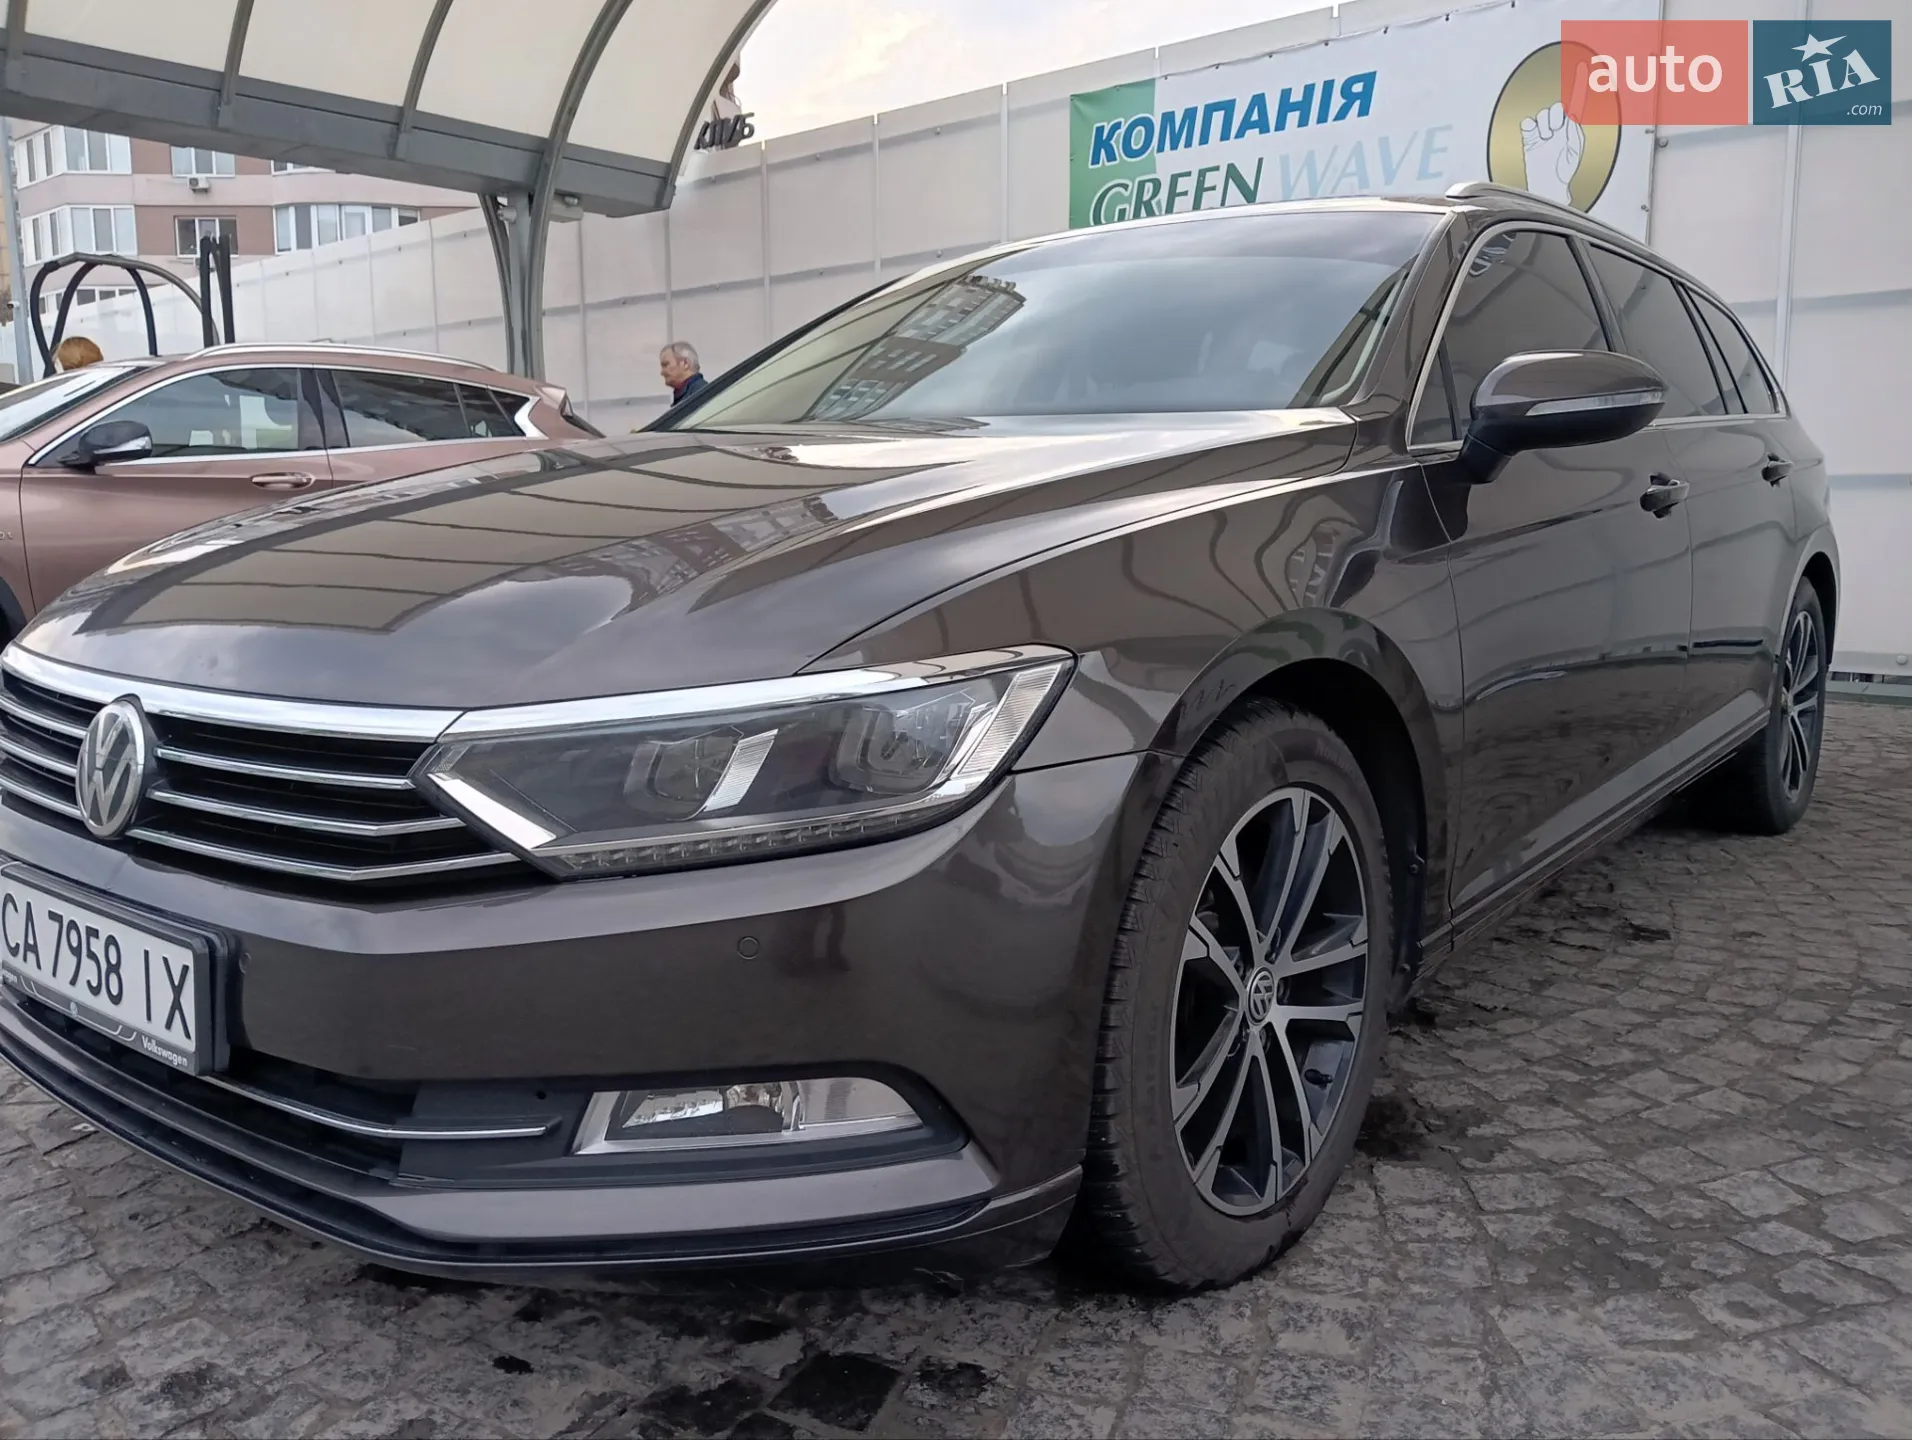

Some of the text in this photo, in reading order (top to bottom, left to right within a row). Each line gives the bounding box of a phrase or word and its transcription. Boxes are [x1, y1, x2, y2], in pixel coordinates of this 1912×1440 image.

[1089, 70, 1378, 167] КОМПАНІЯ
[1091, 124, 1453, 226] GREEN WAVE
[2, 893, 192, 1041] CA 7958 IX
[141, 1035, 188, 1068] Volkswagen
